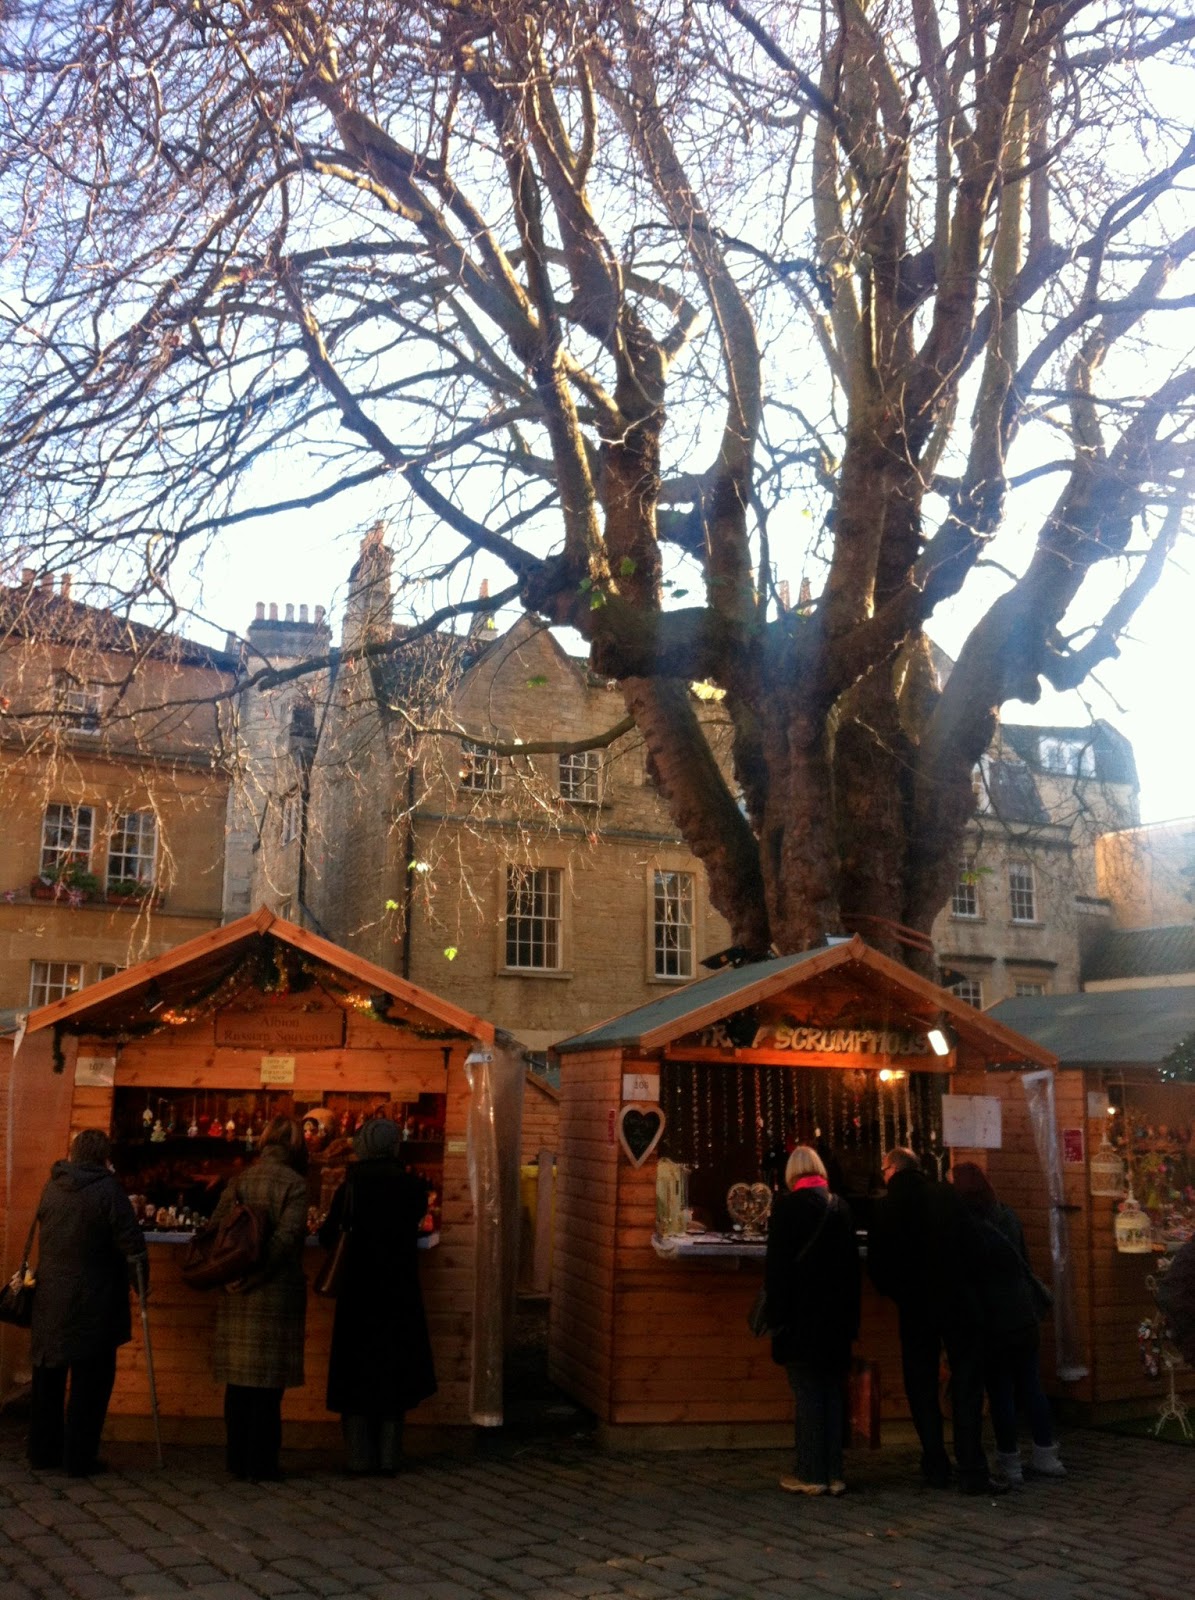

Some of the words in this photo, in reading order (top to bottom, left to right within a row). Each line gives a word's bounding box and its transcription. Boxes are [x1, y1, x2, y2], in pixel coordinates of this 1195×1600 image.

[261, 1015, 300, 1027] Albion
[274, 1029, 336, 1042] Souvenirs
[774, 1026, 929, 1054] SCRUMPTIOUS
